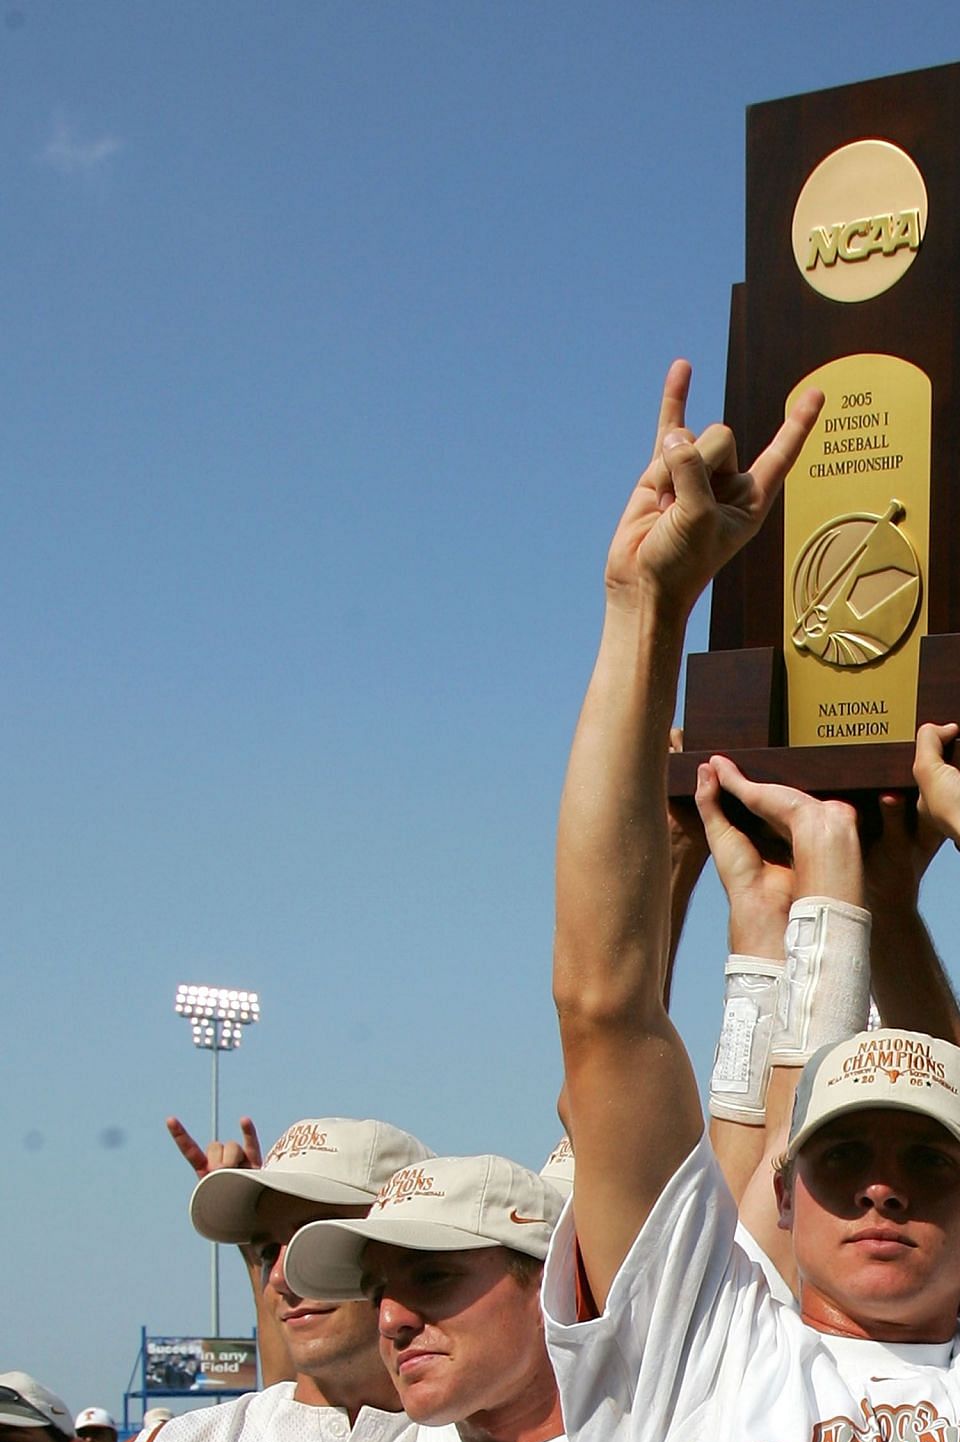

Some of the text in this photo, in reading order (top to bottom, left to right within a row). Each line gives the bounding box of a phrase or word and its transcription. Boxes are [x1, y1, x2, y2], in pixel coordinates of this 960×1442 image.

[806, 209, 921, 270] NCAA
[841, 392, 872, 409] 2005
[824, 411, 889, 433] DIVISION I
[823, 434, 889, 455] BASEBALL
[809, 455, 904, 479] CHAMPIONSHIP
[818, 701, 888, 718] NATIONAL
[817, 721, 889, 738] CHAMPION
[858, 1039, 932, 1058] NATIONAL
[843, 1051, 945, 1078] CHAMPIONS
[219, 1351, 247, 1363] any
[201, 1361, 239, 1373] Field
